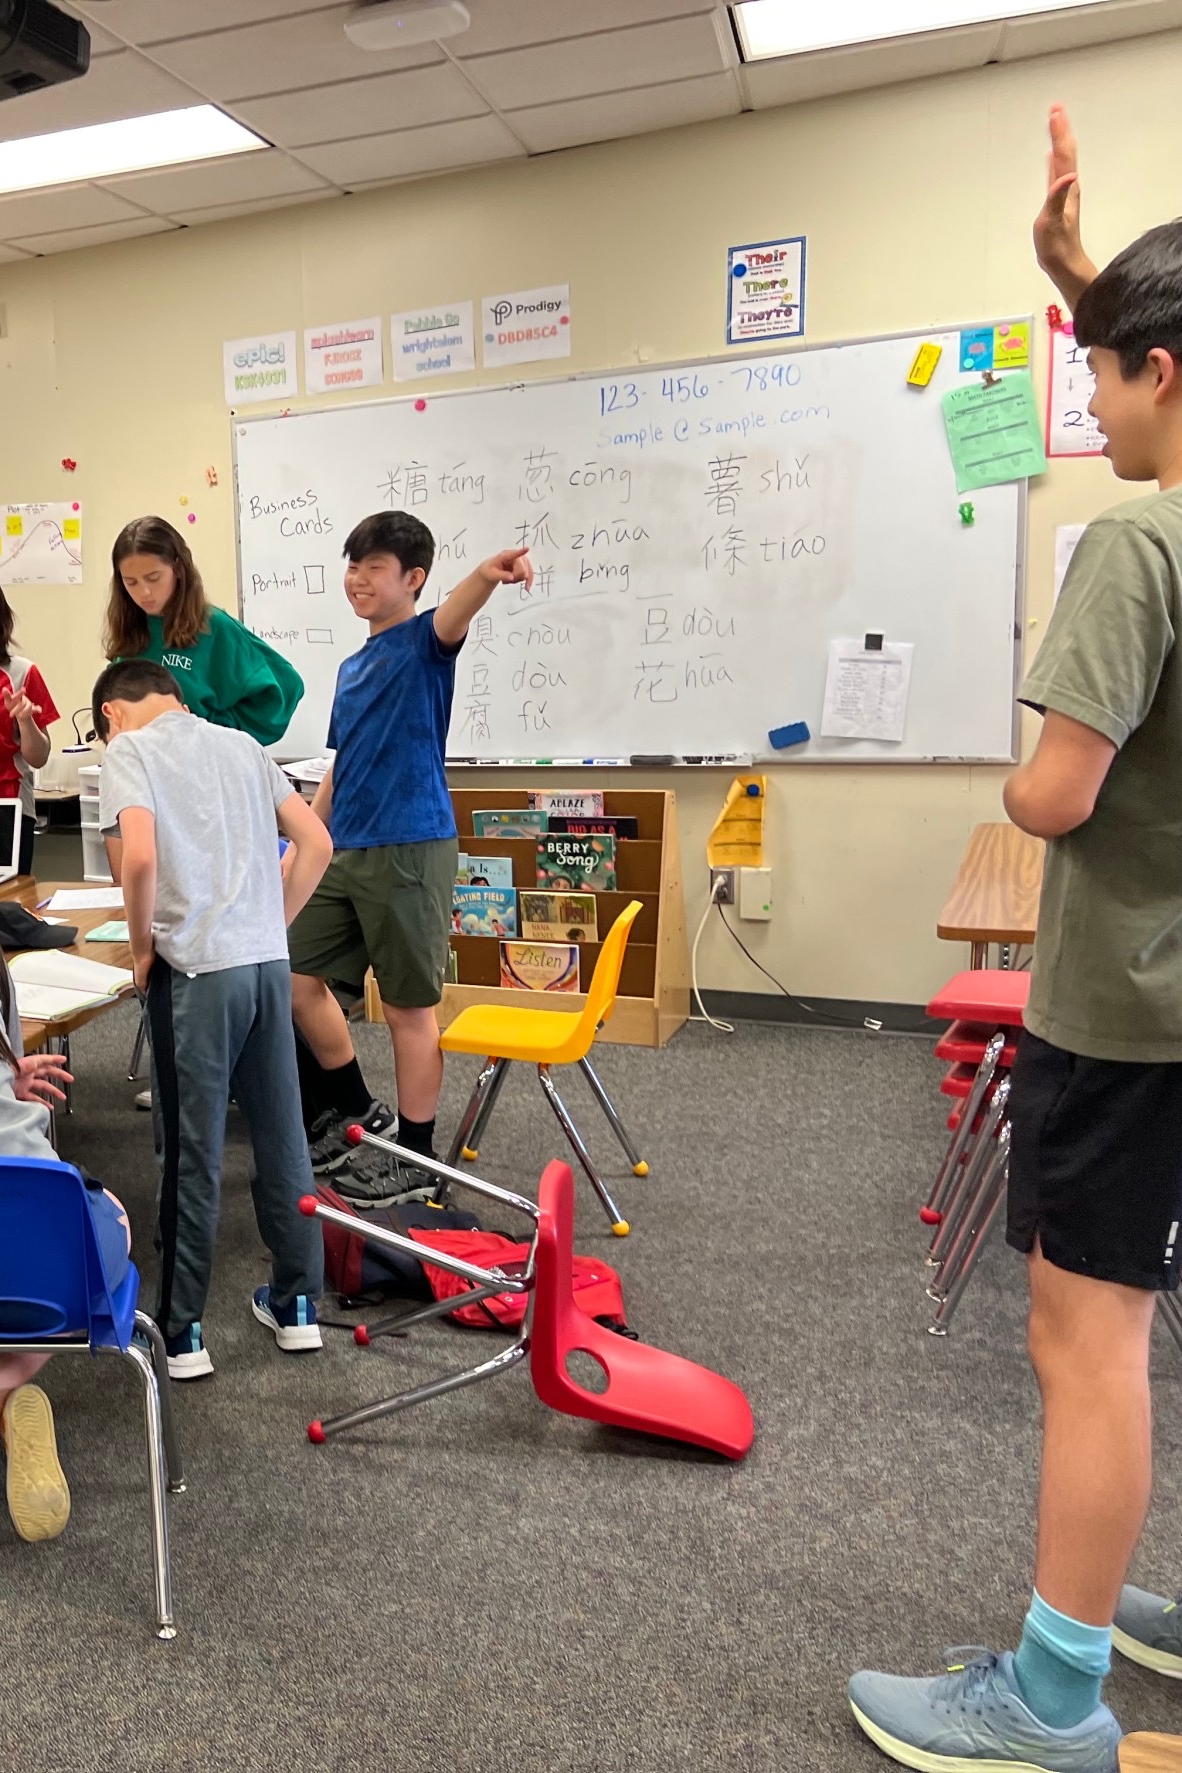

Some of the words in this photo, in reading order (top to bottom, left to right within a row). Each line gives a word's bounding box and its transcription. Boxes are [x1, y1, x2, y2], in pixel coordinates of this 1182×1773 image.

[745, 249, 787, 266] Their
[743, 278, 788, 293] There
[516, 300, 562, 314] Prodigy
[737, 307, 793, 324] They're
[233, 342, 286, 368] epic!
[1062, 410, 1085, 428] 2
[250, 489, 318, 519] Business
[280, 508, 333, 537] Cards
[252, 571, 298, 596] Portrait
[161, 653, 193, 671] NIKE
[467, 663, 491, 697] 豆
[547, 842, 589, 853] BERRY
[556, 849, 600, 873] Song
[484, 892, 505, 902] FIELD
[514, 947, 562, 969] Listen
